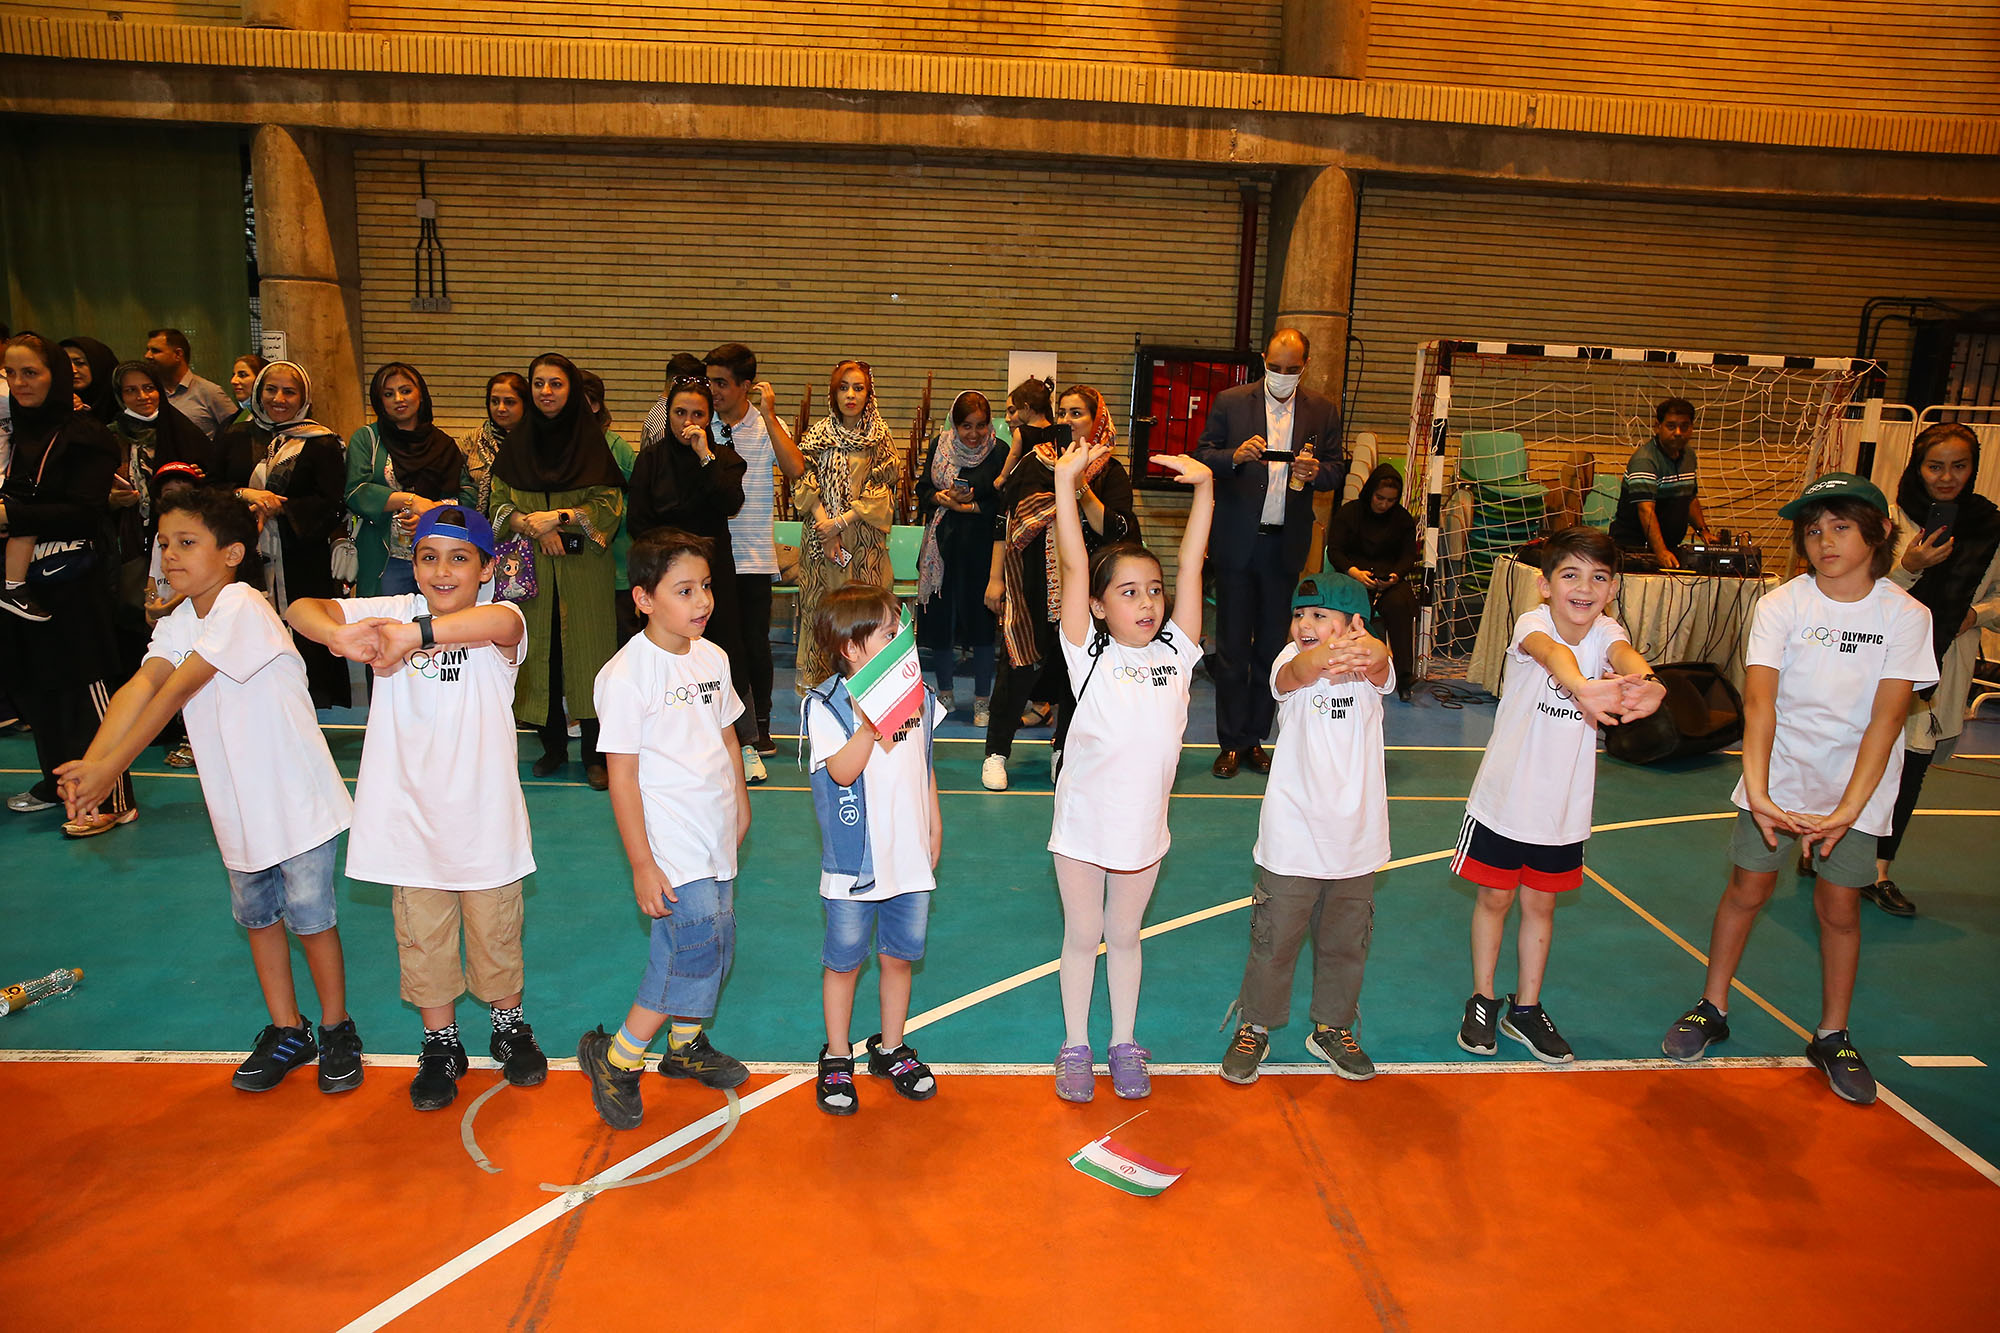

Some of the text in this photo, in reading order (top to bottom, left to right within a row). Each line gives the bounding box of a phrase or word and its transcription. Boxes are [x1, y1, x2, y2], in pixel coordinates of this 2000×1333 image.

[1841, 631, 1884, 645] OLYMPIC
[1839, 643, 1858, 654] DAY
[440, 668, 460, 682] DAY
[1152, 676, 1168, 687] DAY
[1331, 709, 1346, 719] DAY
[892, 730, 908, 743] DAY
[1684, 1014, 1707, 1026] AIR
[1836, 1049, 1858, 1060] AIR
